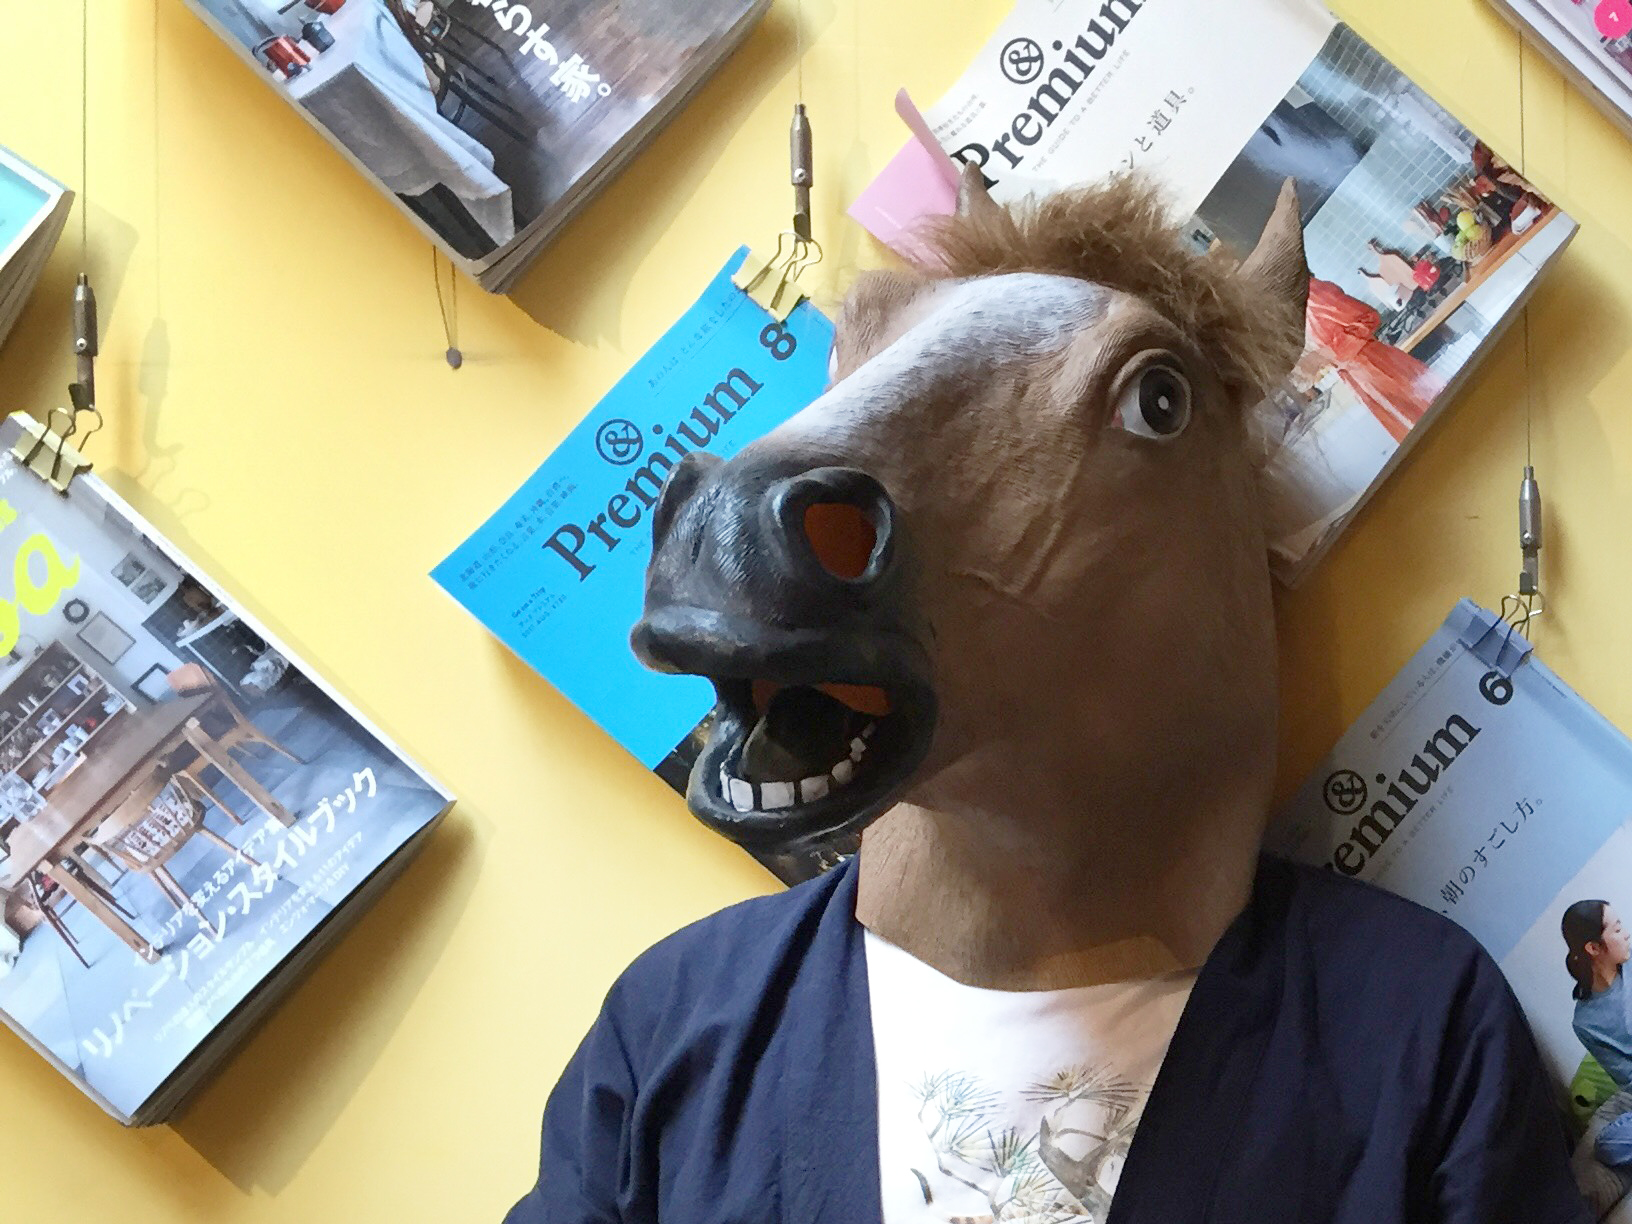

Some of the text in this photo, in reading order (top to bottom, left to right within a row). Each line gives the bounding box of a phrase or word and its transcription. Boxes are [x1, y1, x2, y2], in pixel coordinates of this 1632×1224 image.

[471, 0, 611, 103] らす家。
[1003, 40, 1044, 80] &
[1109, 87, 1195, 178] ンと道具。
[759, 322, 797, 360] 8
[599, 421, 643, 462] &
[541, 367, 764, 583] Premium
[1478, 671, 1514, 706] 6
[1325, 713, 1482, 876] emium
[1327, 771, 1367, 812] &
